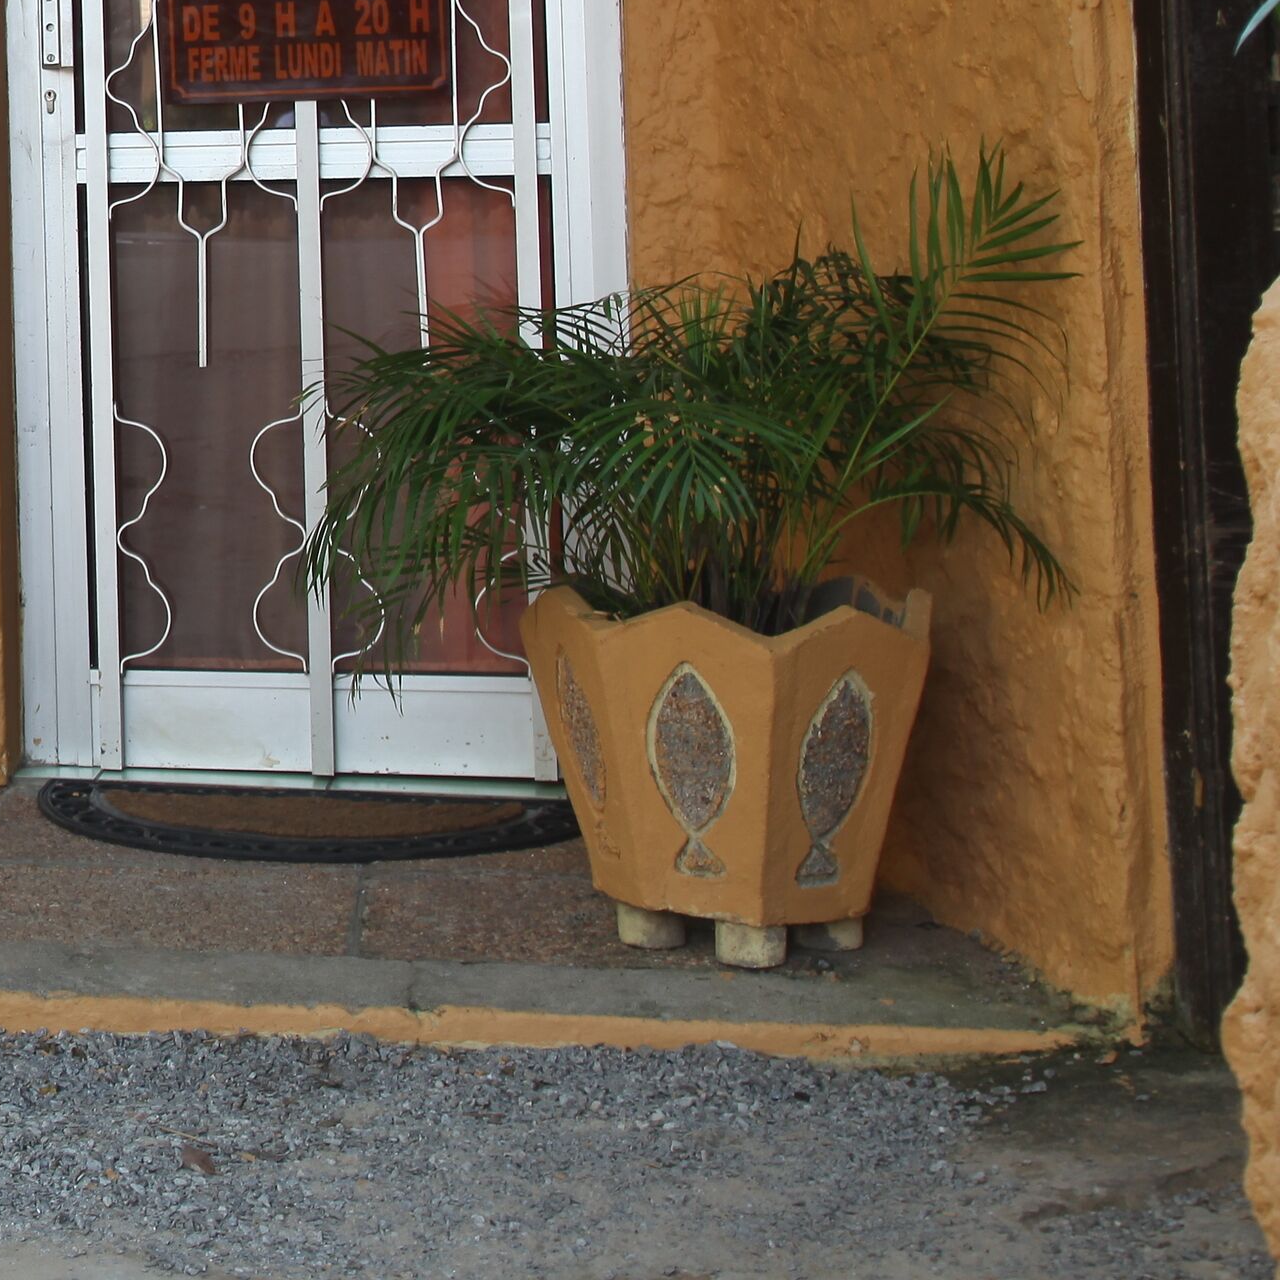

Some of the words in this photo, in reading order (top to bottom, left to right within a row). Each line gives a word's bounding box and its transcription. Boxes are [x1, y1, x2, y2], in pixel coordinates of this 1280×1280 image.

[182, 4, 220, 42] DE
[240, 3, 256, 40] 9
[276, 1, 295, 38] H
[316, 0, 336, 35] A
[188, 45, 261, 82] FERME
[275, 42, 341, 79] LUNDI
[356, 39, 427, 76] MATIN
